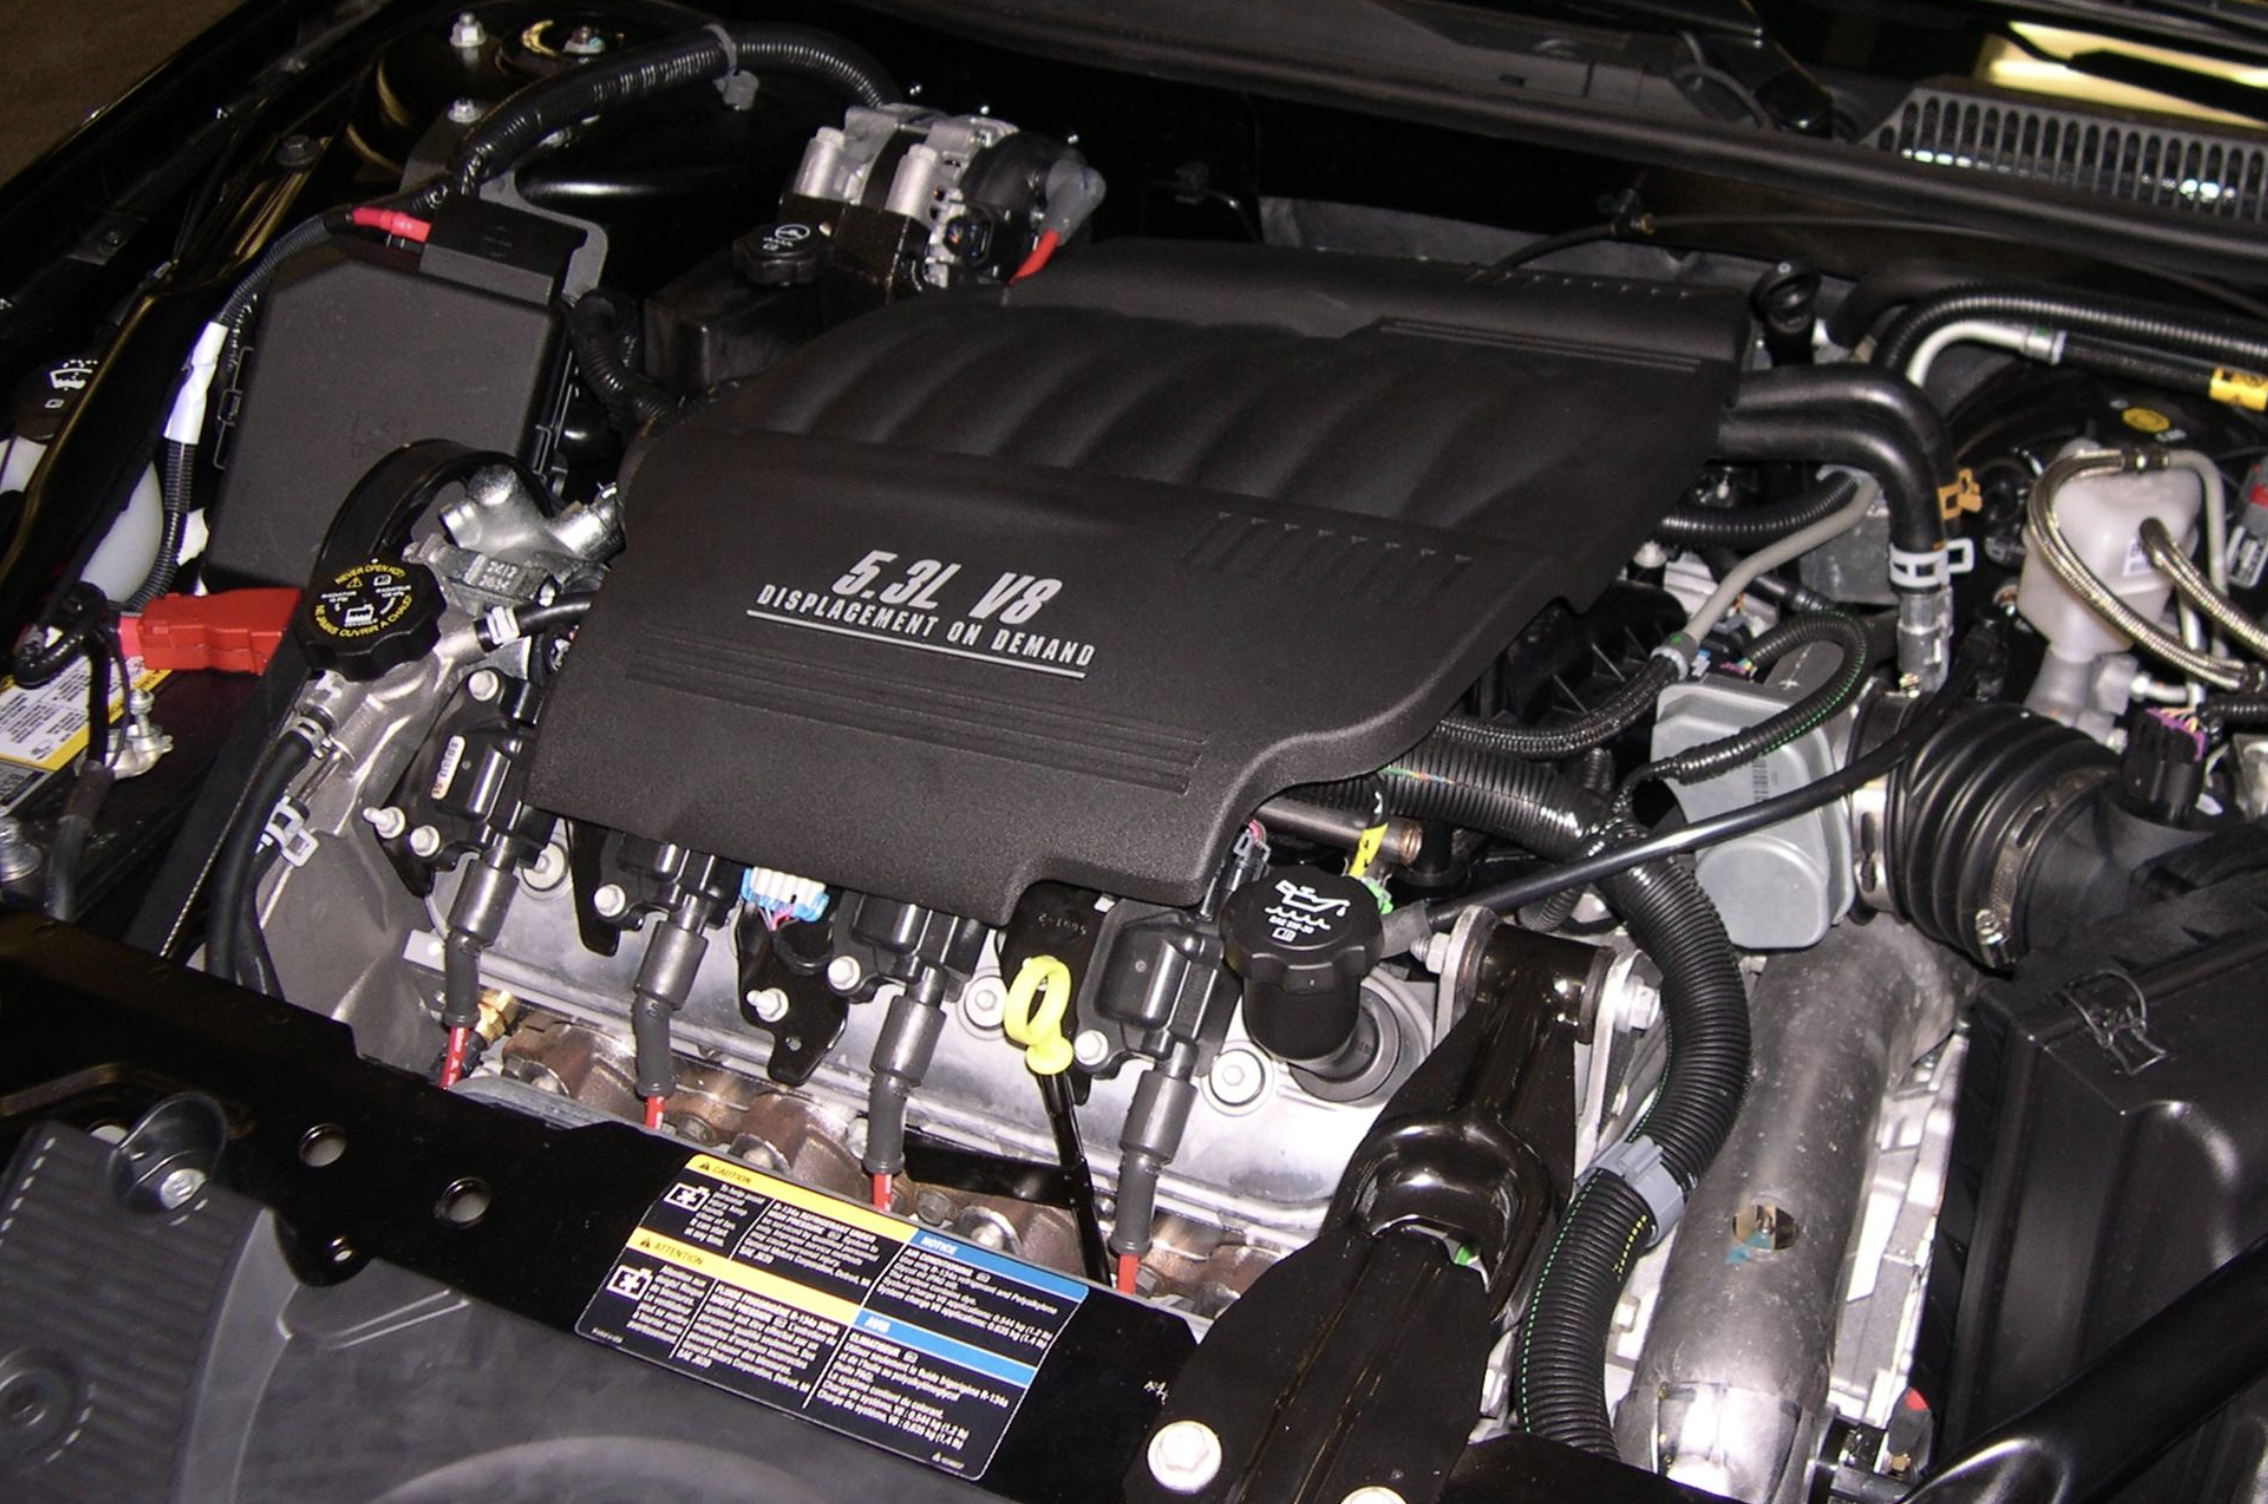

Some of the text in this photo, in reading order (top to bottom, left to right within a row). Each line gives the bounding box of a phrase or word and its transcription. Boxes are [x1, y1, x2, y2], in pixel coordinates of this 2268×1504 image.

[832, 550, 1063, 625] 5.3L V8
[756, 584, 1095, 667] DISPLACEMENT ON DEMAND
[651, 1241, 705, 1266] ATTENTION
[919, 1235, 958, 1255] NOTICE
